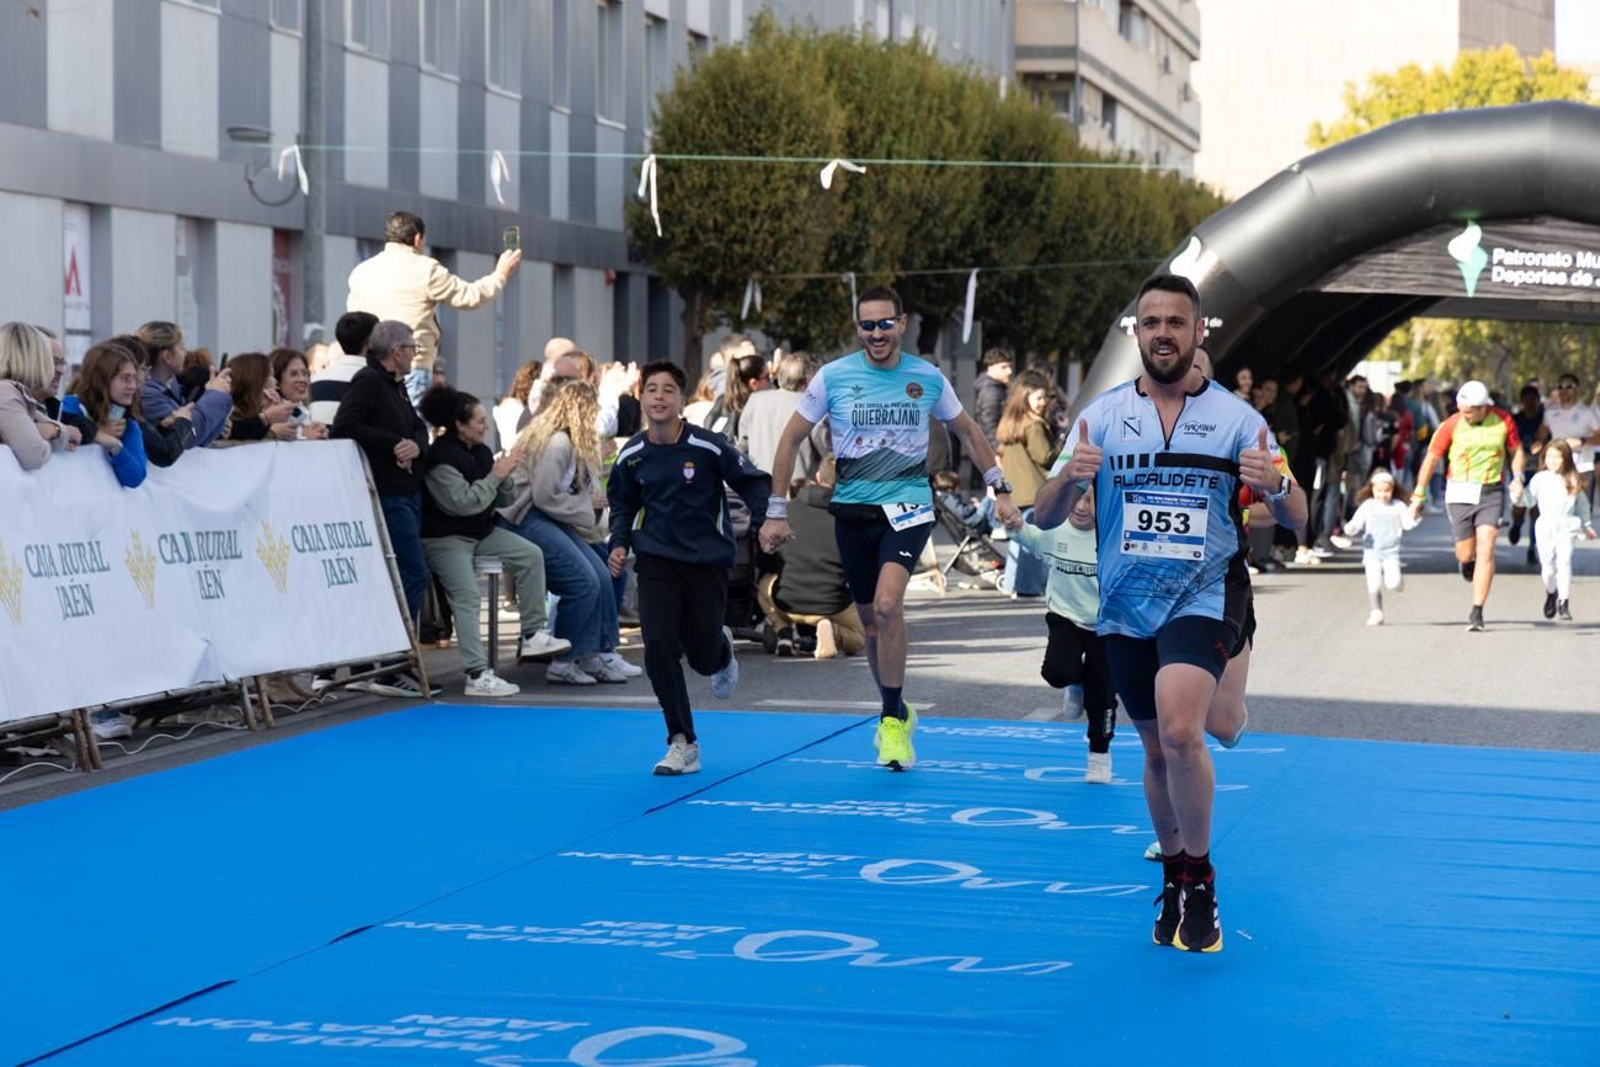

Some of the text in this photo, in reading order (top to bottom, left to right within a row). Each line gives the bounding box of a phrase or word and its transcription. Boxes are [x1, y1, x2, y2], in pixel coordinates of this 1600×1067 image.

[1492, 247, 1573, 267] Patronato
[1492, 266, 1567, 287] Deportes
[1570, 269, 1593, 286] de
[852, 409, 920, 427] QUIEBRAJANO
[1113, 473, 1219, 489] ALCAUDETE
[1138, 510, 1190, 534] 953
[195, 530, 242, 561] RURAL
[323, 521, 373, 550] RURAL
[57, 541, 110, 576] RURAL
[322, 552, 359, 589] JAÉN
[55, 578, 95, 621] JAÉN
[247, 1032, 502, 1051] MEDIA
